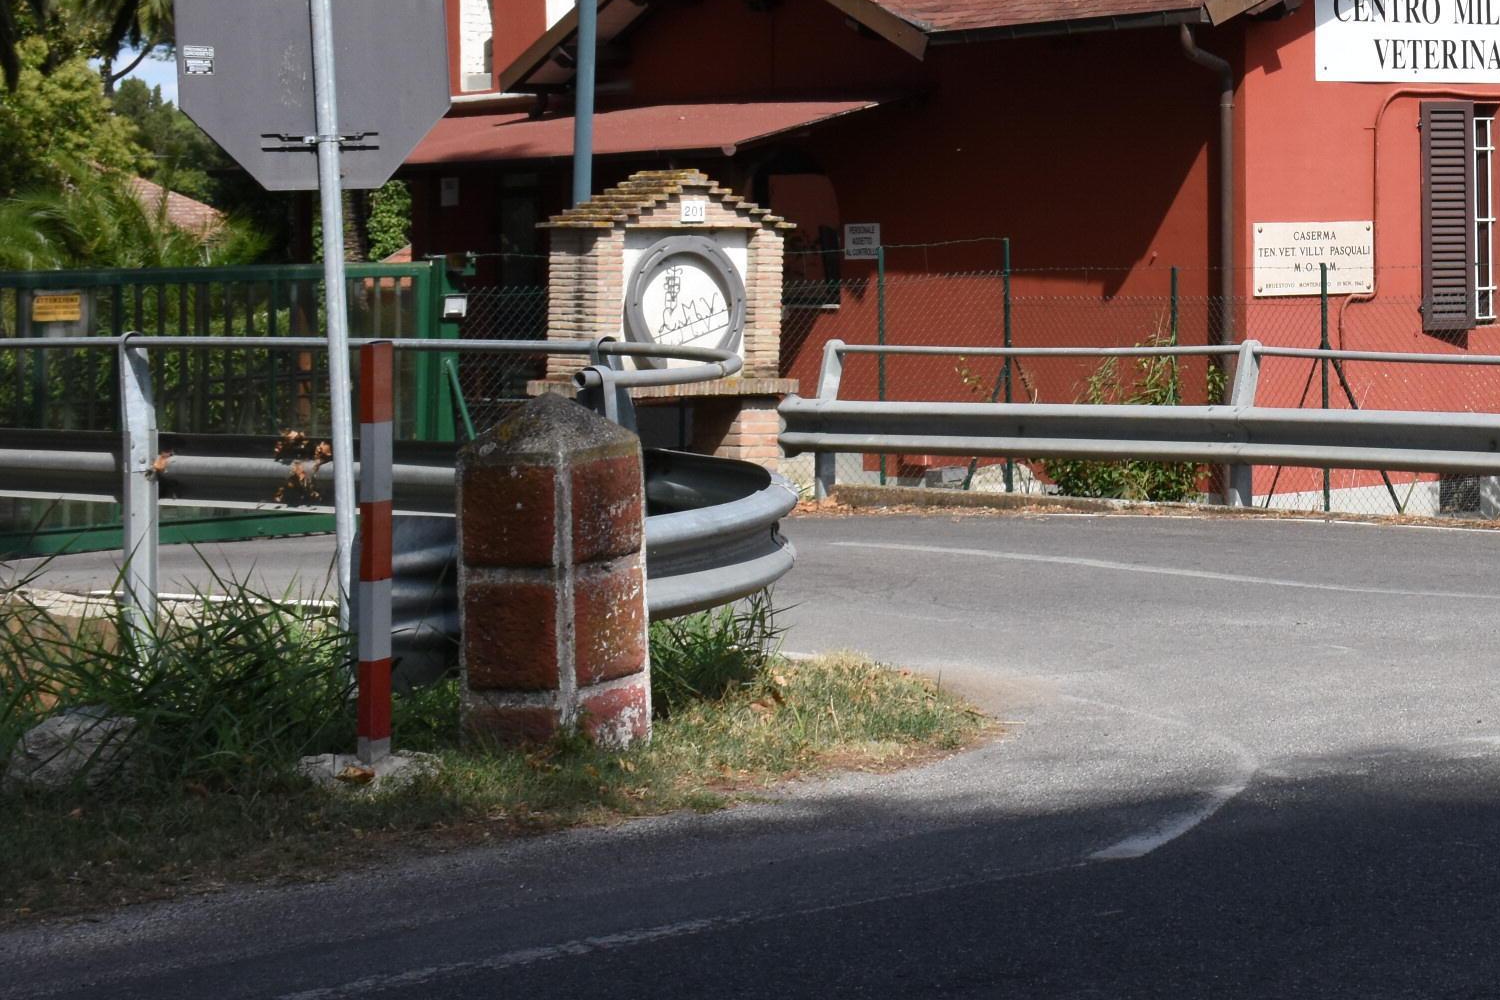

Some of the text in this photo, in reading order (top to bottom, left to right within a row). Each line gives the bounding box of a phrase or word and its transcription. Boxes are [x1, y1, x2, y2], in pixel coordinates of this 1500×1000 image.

[684, 205, 703, 217] 201
[1293, 231, 1337, 241] CASERMA
[1300, 246, 1325, 257] VILLY
[1329, 245, 1371, 257] PASQUALI
